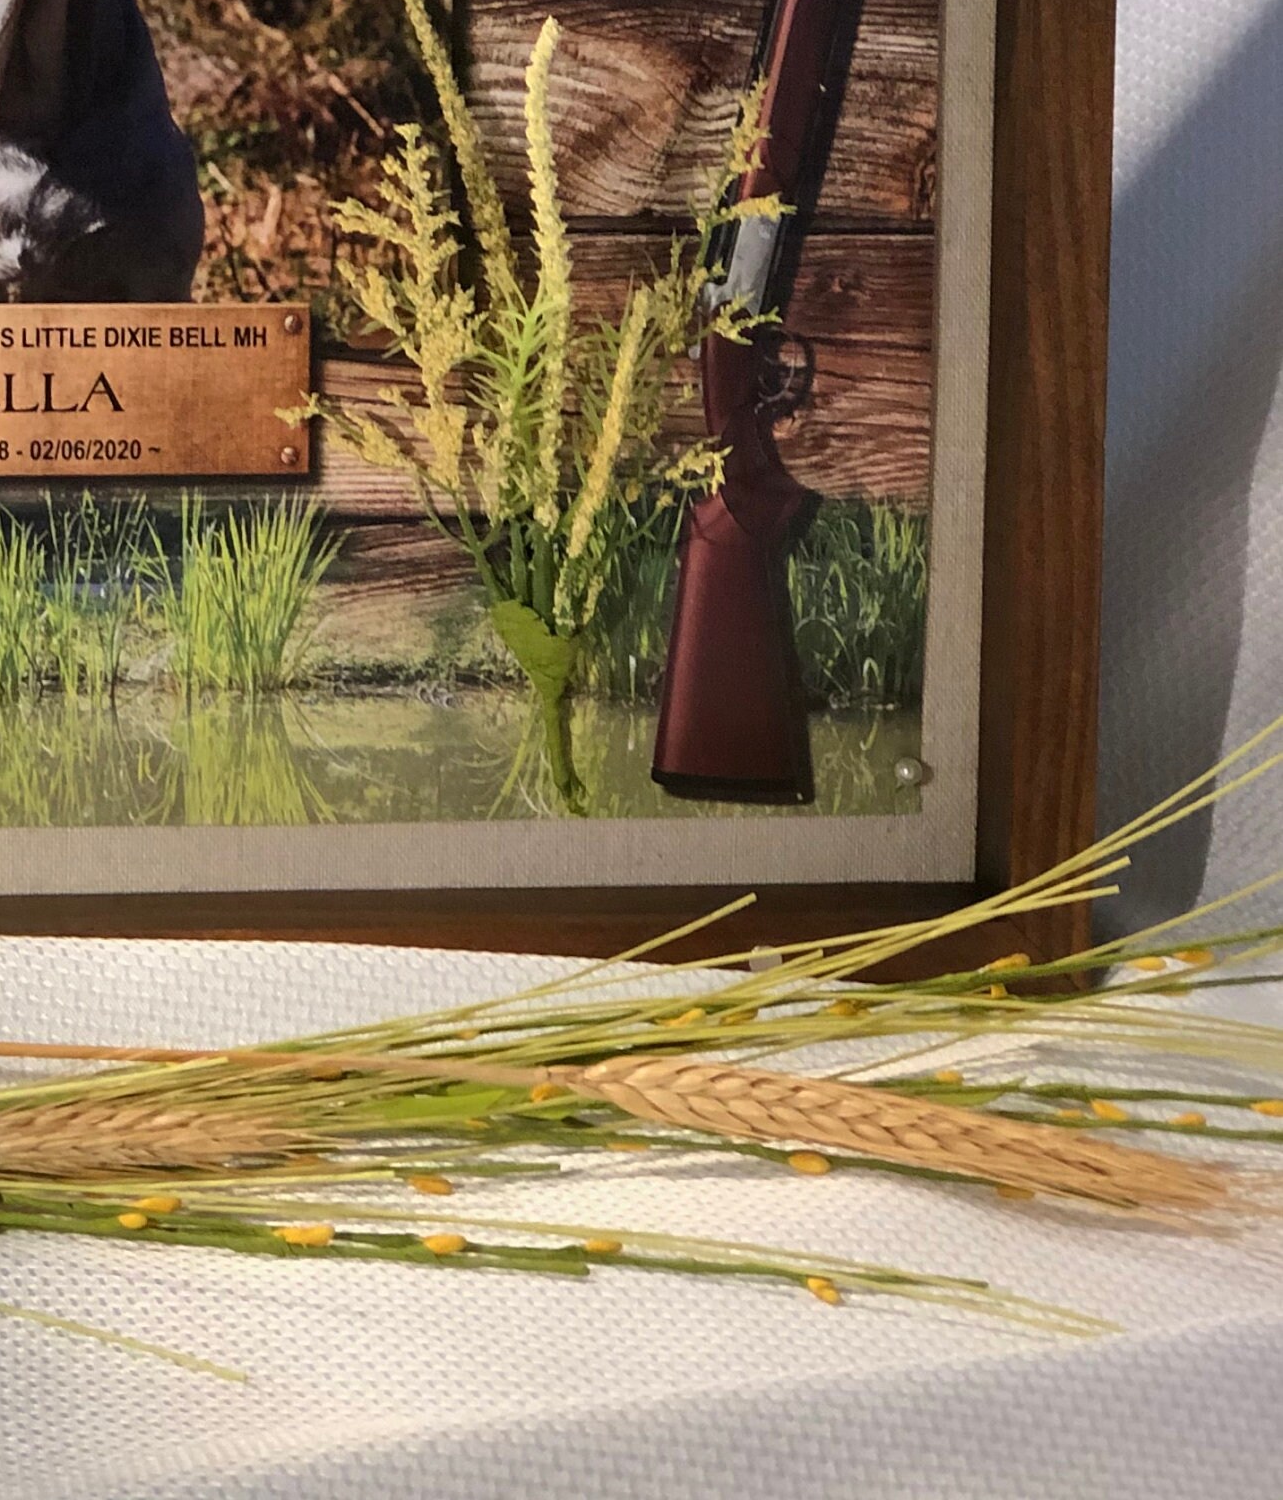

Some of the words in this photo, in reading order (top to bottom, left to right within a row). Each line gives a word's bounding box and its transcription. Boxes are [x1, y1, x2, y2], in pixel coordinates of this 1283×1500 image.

[22, 327, 97, 348] LITTLE
[104, 326, 162, 348] DIXIE
[169, 326, 227, 348] BELL
[233, 326, 267, 348] MH
[29, 439, 142, 461] 02/06/2020
